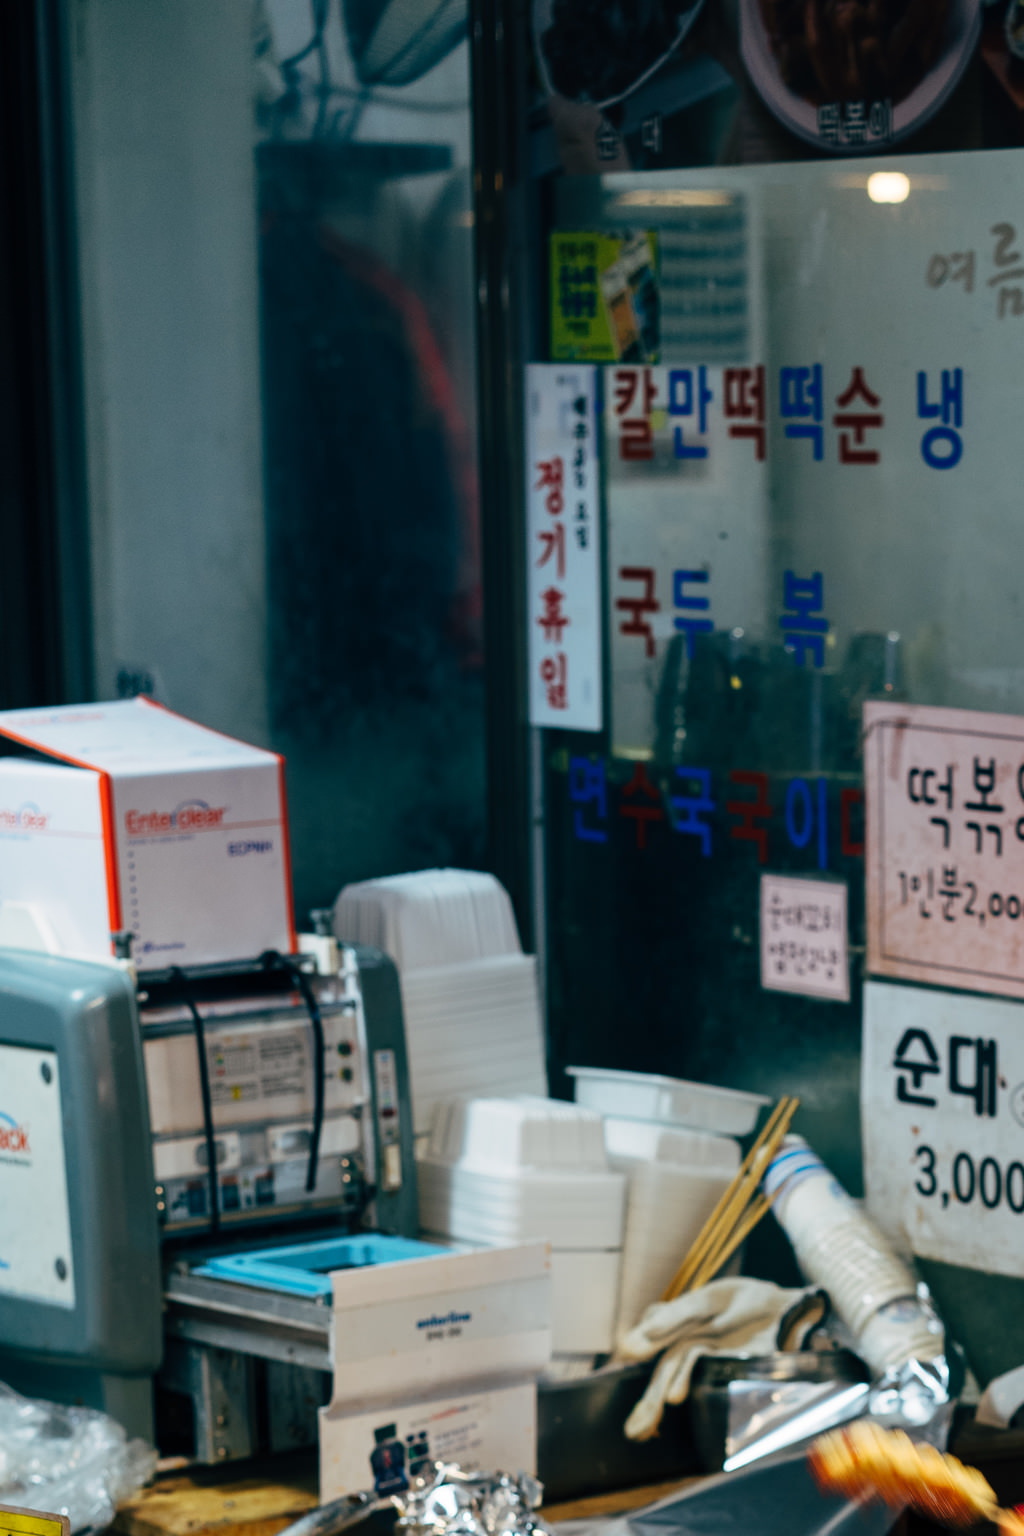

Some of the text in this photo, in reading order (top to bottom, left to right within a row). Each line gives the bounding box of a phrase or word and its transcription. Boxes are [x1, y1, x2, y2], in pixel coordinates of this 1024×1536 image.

[818, 98, 892, 144] 떡볶이
[536, 456, 569, 709] 정기휴일
[893, 1027, 997, 1118] 순대
